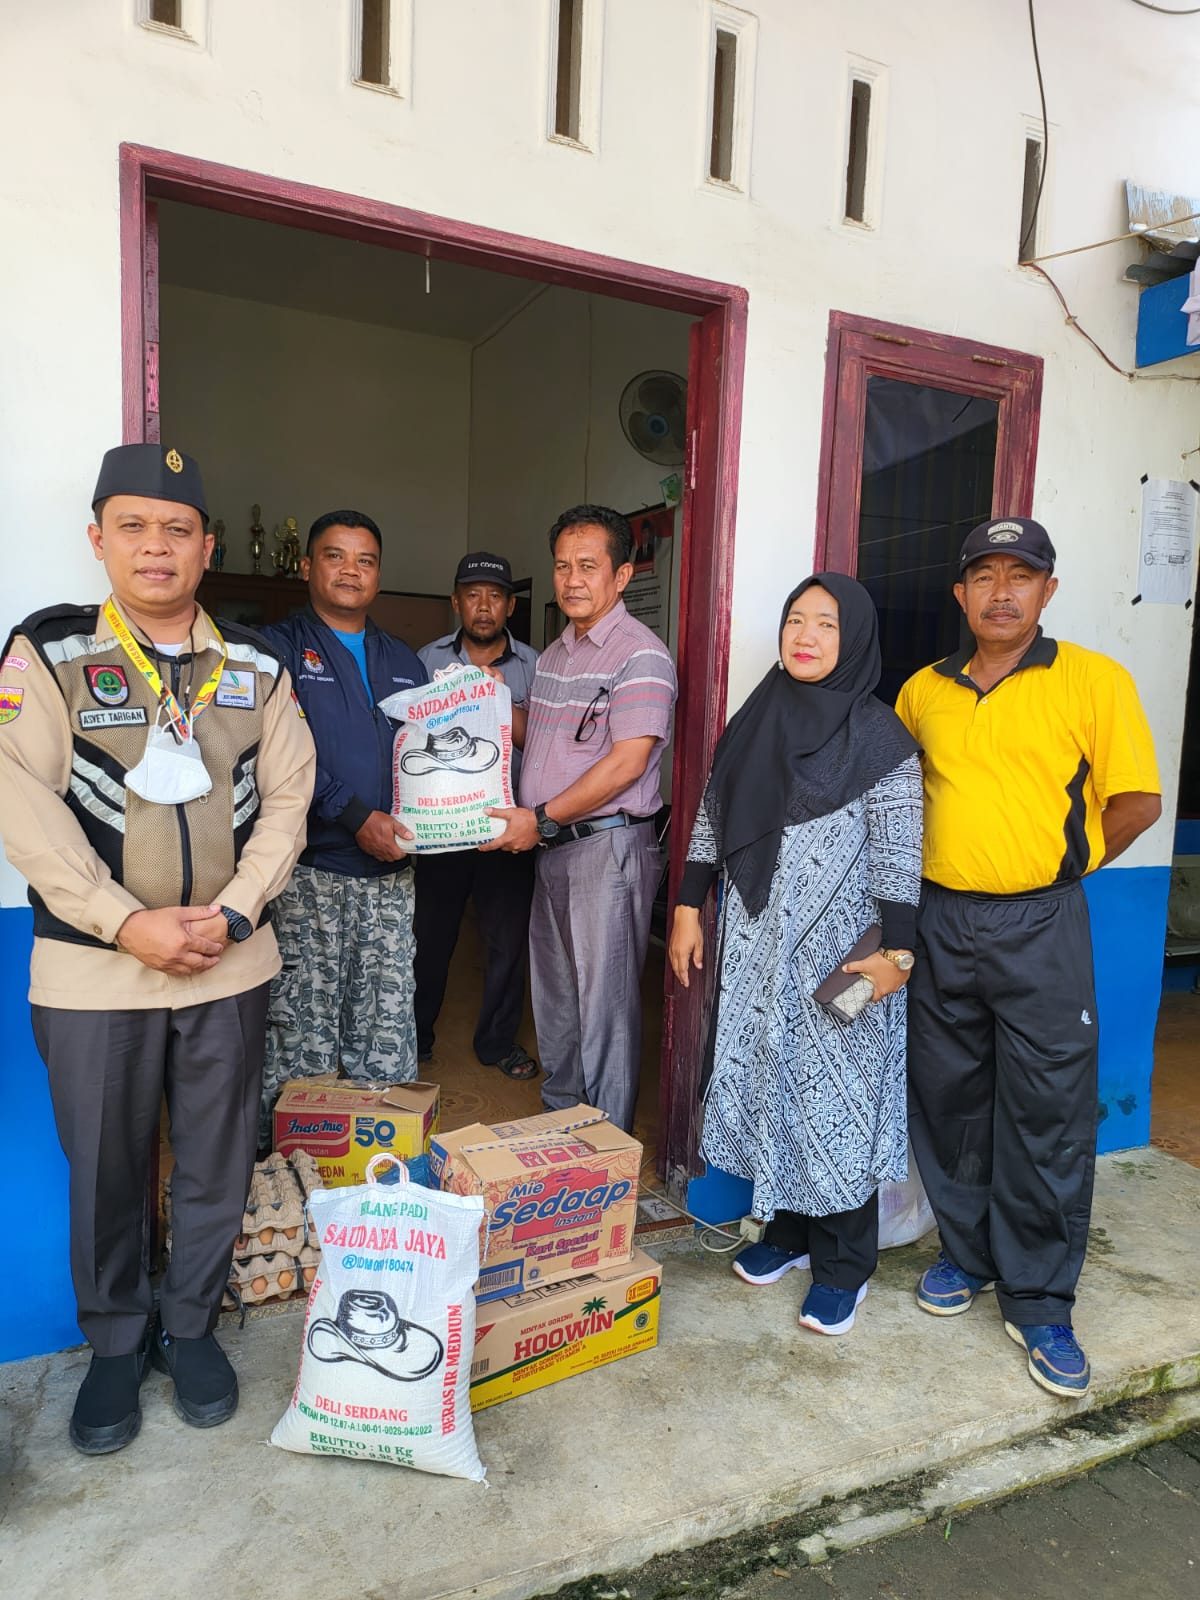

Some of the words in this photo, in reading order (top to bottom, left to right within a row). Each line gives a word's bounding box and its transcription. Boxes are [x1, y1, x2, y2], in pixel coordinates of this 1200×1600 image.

[464, 671, 485, 682] PADI
[408, 689, 467, 720] SAUDARA
[471, 682, 496, 699] JAYA
[109, 711, 143, 722] TARIGAN
[500, 724, 512, 762] MEDIUM
[502, 763, 509, 774] IR
[417, 797, 439, 806] DELI
[441, 790, 486, 805] SERDANG
[415, 822, 458, 831] BRUTTO
[466, 819, 475, 827] 10
[478, 816, 490, 825] Kg
[416, 832, 452, 840] NETTO
[460, 828, 477, 837] 9,95
[479, 825, 492, 834] Kg
[355, 1120, 395, 1147] 50
[306, 1147, 328, 1155] Instan
[510, 1182, 544, 1199] Mie
[400, 1202, 428, 1221] PADI
[488, 1180, 631, 1231] Sedaap
[554, 1210, 599, 1228] Instant
[323, 1223, 398, 1251] SAUDARA
[404, 1229, 447, 1260] JAYA
[525, 1241, 554, 1258] Kari
[520, 1322, 547, 1336] MINYAK
[547, 1312, 574, 1327] GORENG
[446, 1304, 462, 1367] MEDIUM
[513, 1310, 614, 1361] HOOWIN
[444, 1369, 458, 1387] IR
[513, 1362, 539, 1378] MINYAK
[315, 1395, 341, 1415] DELI
[345, 1405, 409, 1422] SERDANG
[442, 1388, 456, 1436] BERAS
[319, 1412, 329, 1424] PD
[310, 1431, 366, 1450] BRUTTO
[378, 1444, 391, 1453] 10
[395, 1446, 413, 1458] Kg
[311, 1443, 358, 1457] NETTO
[397, 1456, 415, 1466] Kg
